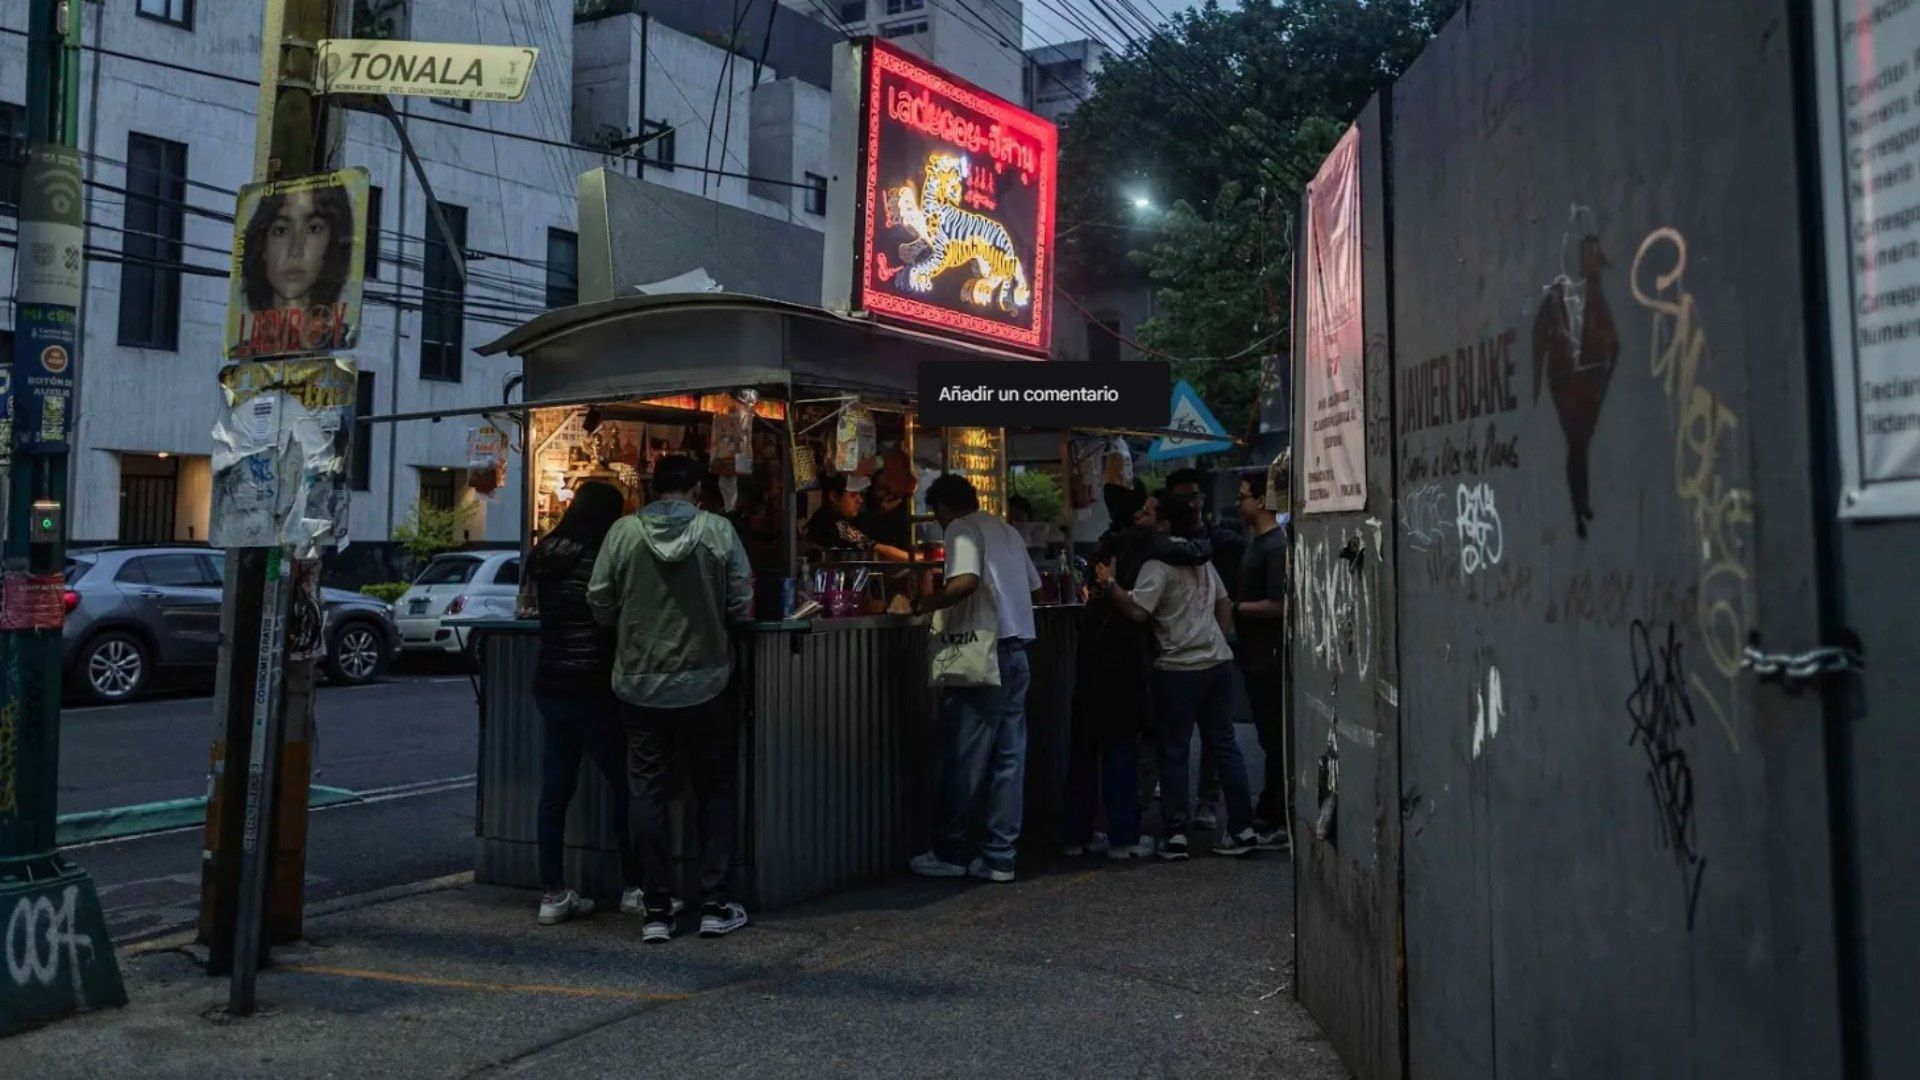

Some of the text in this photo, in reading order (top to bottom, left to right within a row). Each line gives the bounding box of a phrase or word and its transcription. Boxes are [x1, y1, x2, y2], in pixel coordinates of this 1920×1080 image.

[350, 52, 483, 86] TONALA
[1401, 355, 1451, 433] JAVIER
[1455, 329, 1517, 421] BLAKE
